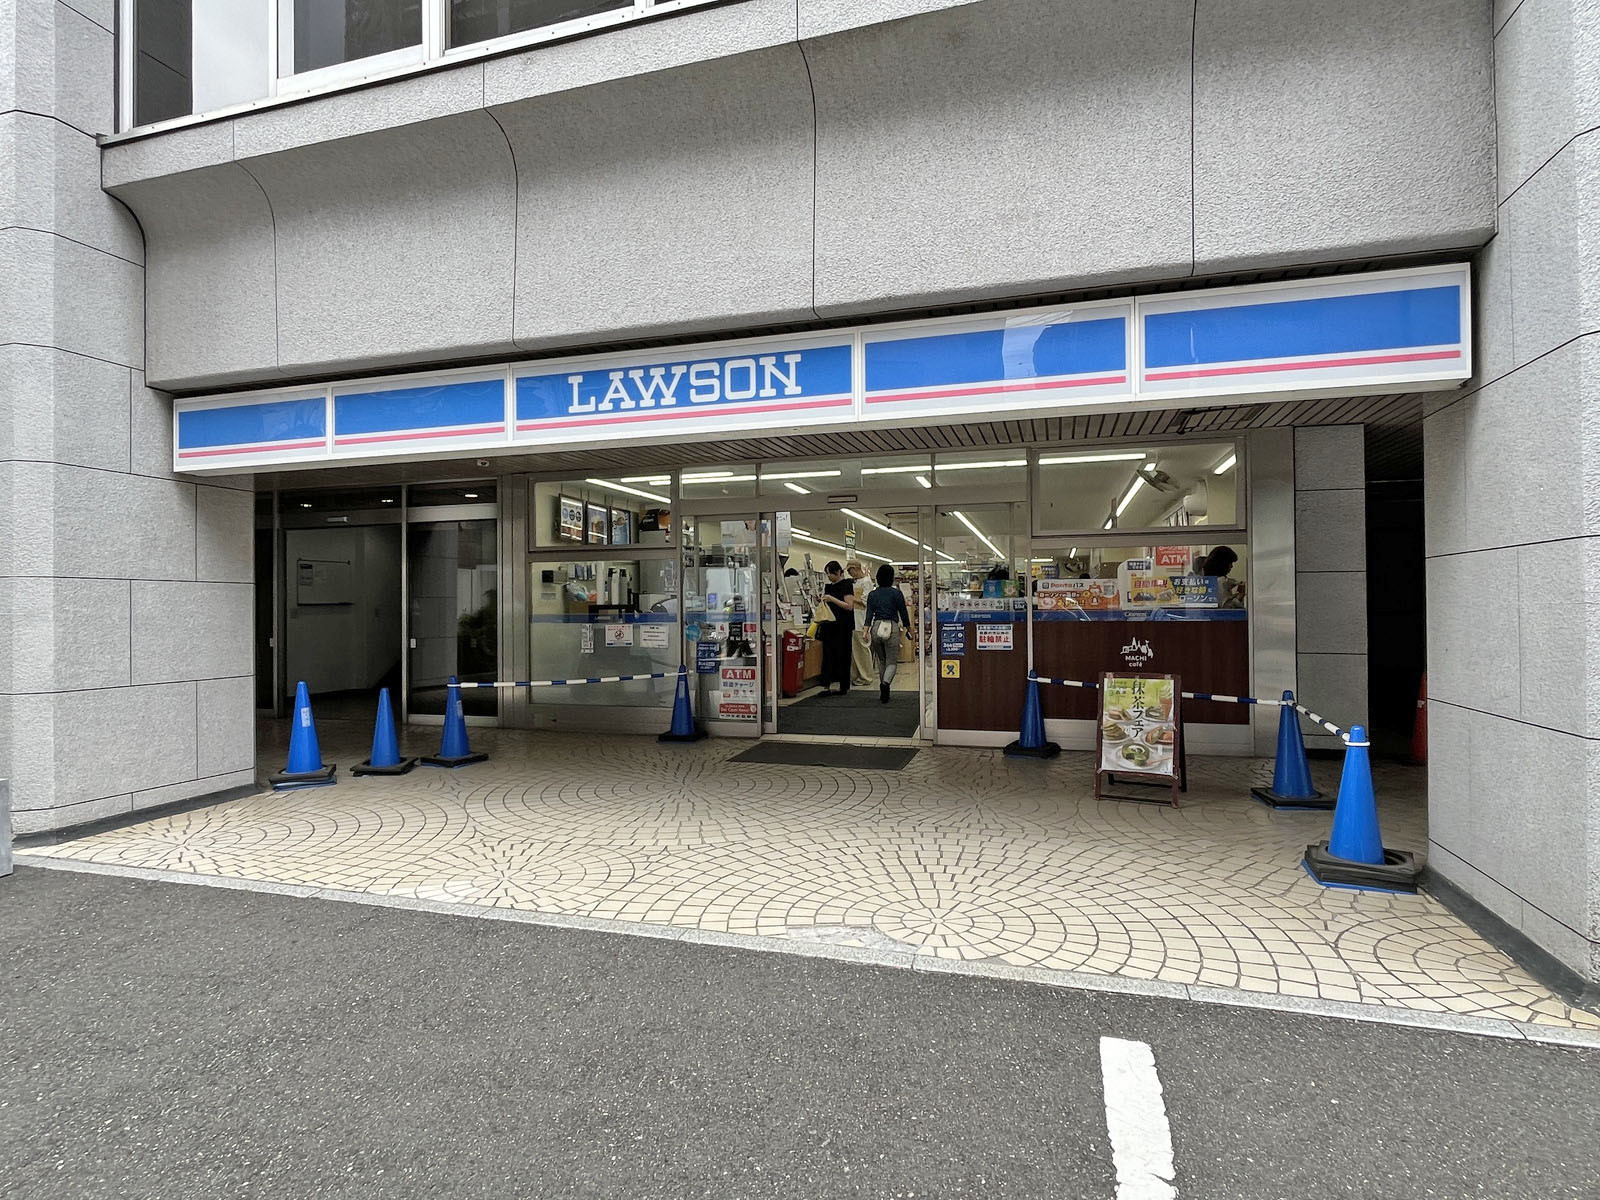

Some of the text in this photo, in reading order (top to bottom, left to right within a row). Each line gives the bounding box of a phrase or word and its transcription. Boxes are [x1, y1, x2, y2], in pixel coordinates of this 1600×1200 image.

[568, 354, 802, 414] LAWSON
[1161, 554, 1187, 564] ATM
[979, 635, 1010, 643] 駐輪禁止
[726, 669, 752, 679] ATM
[1132, 679, 1146, 738] 抹茶フェア
